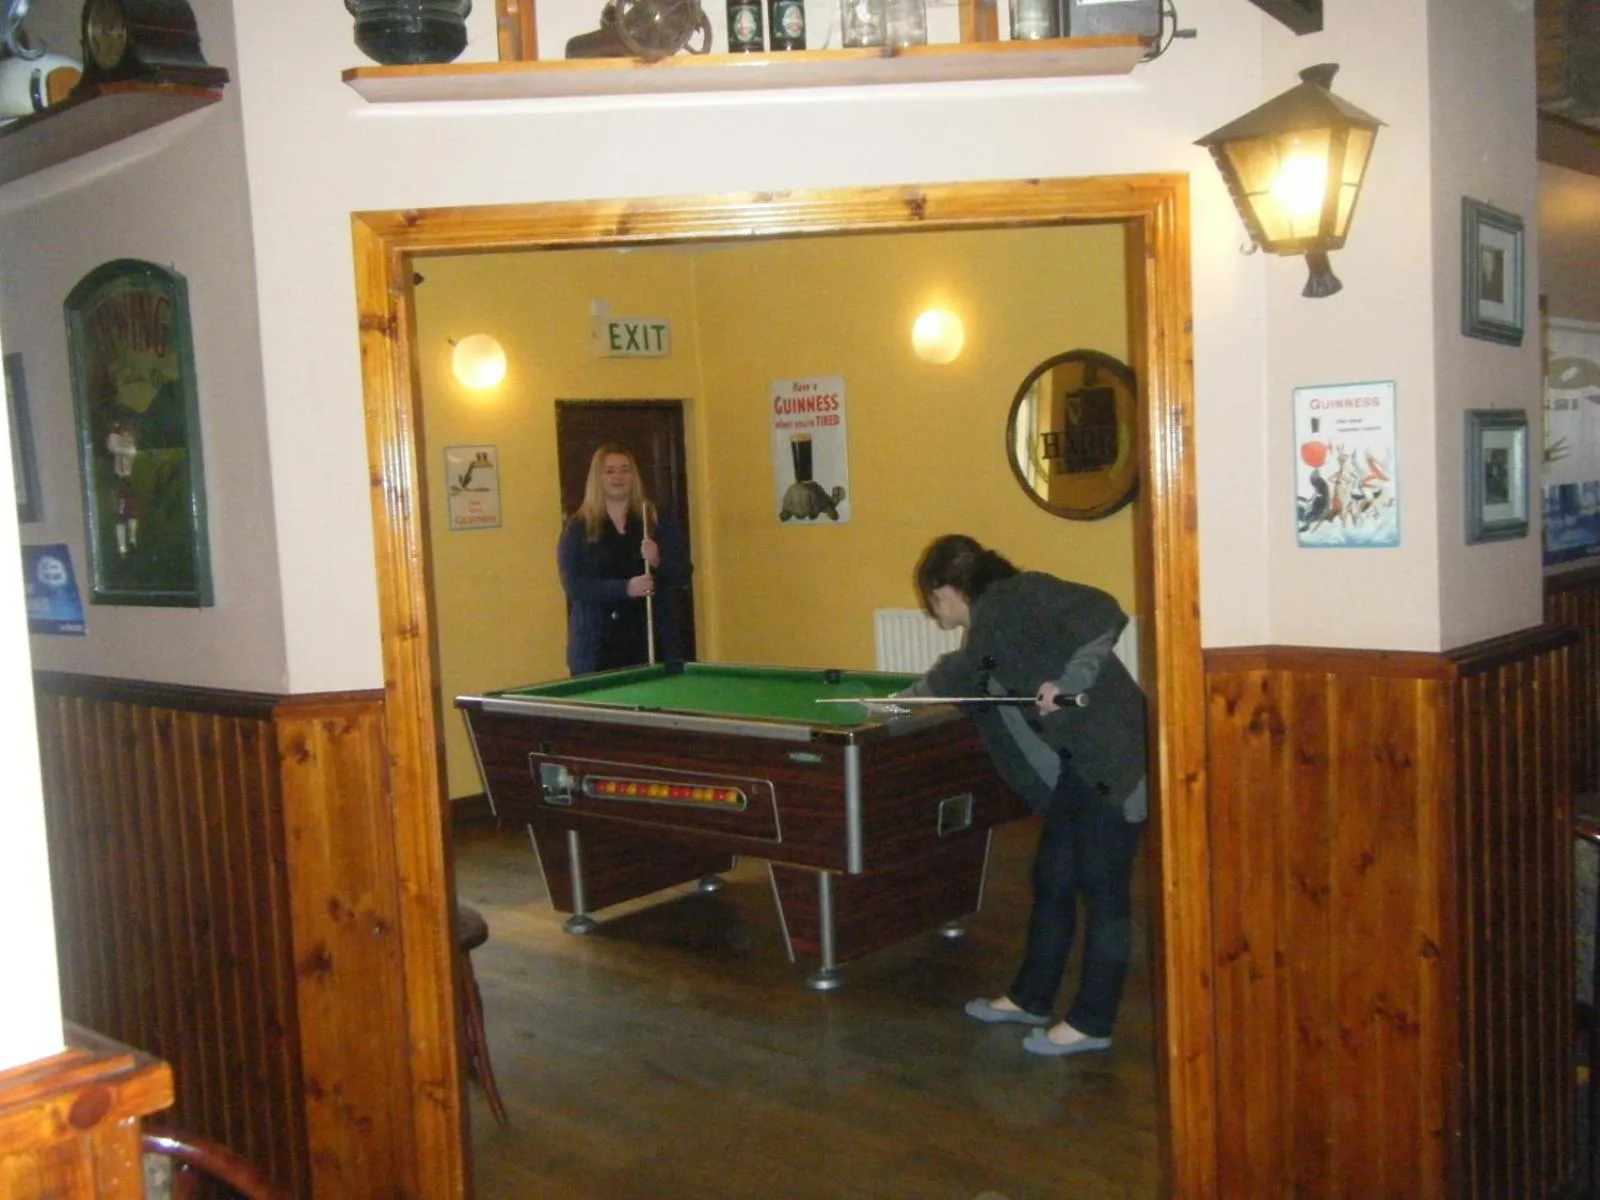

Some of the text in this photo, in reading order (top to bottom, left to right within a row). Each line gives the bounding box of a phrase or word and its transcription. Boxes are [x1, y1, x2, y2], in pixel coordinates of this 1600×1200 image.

[608, 322, 666, 352] EXIT
[774, 393, 839, 415] GUINNESS
[1310, 396, 1381, 410] GUINNESS
[816, 414, 840, 427] TIRED
